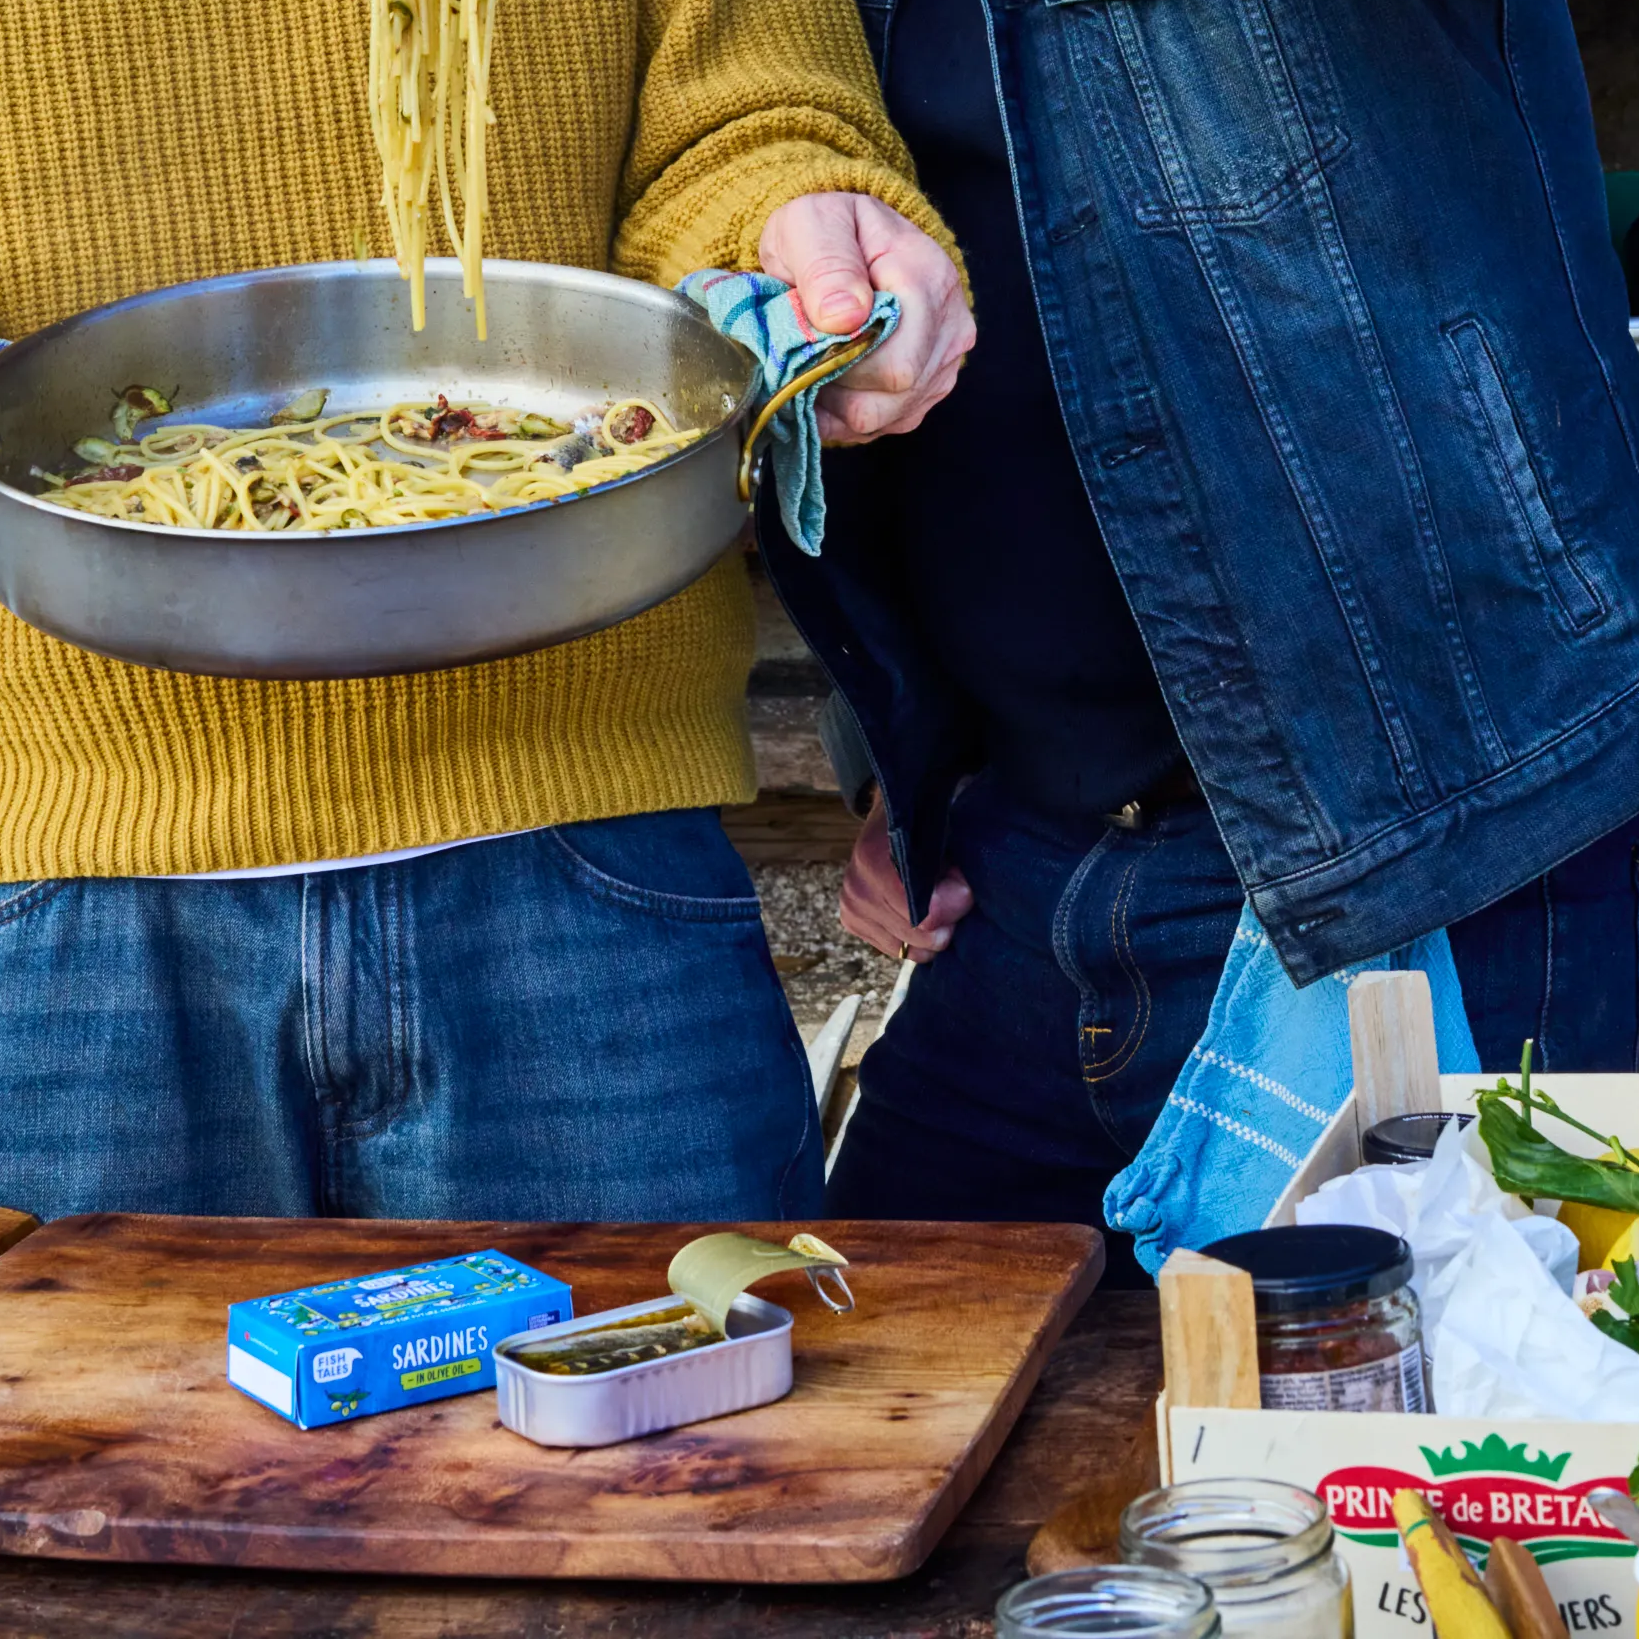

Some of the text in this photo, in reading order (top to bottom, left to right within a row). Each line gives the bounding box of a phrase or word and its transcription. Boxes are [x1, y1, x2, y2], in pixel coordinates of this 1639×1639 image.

[355, 1280, 454, 1307] SARDINES
[318, 1352, 346, 1367] FISH
[392, 1325, 488, 1370] SARDINES
[317, 1364, 348, 1379] TALES
[416, 1363, 466, 1385] IN OLIVE OIL
[1325, 1484, 1446, 1520] PRINE
[1452, 1493, 1484, 1523] de
[1378, 1581, 1427, 1625] LES
